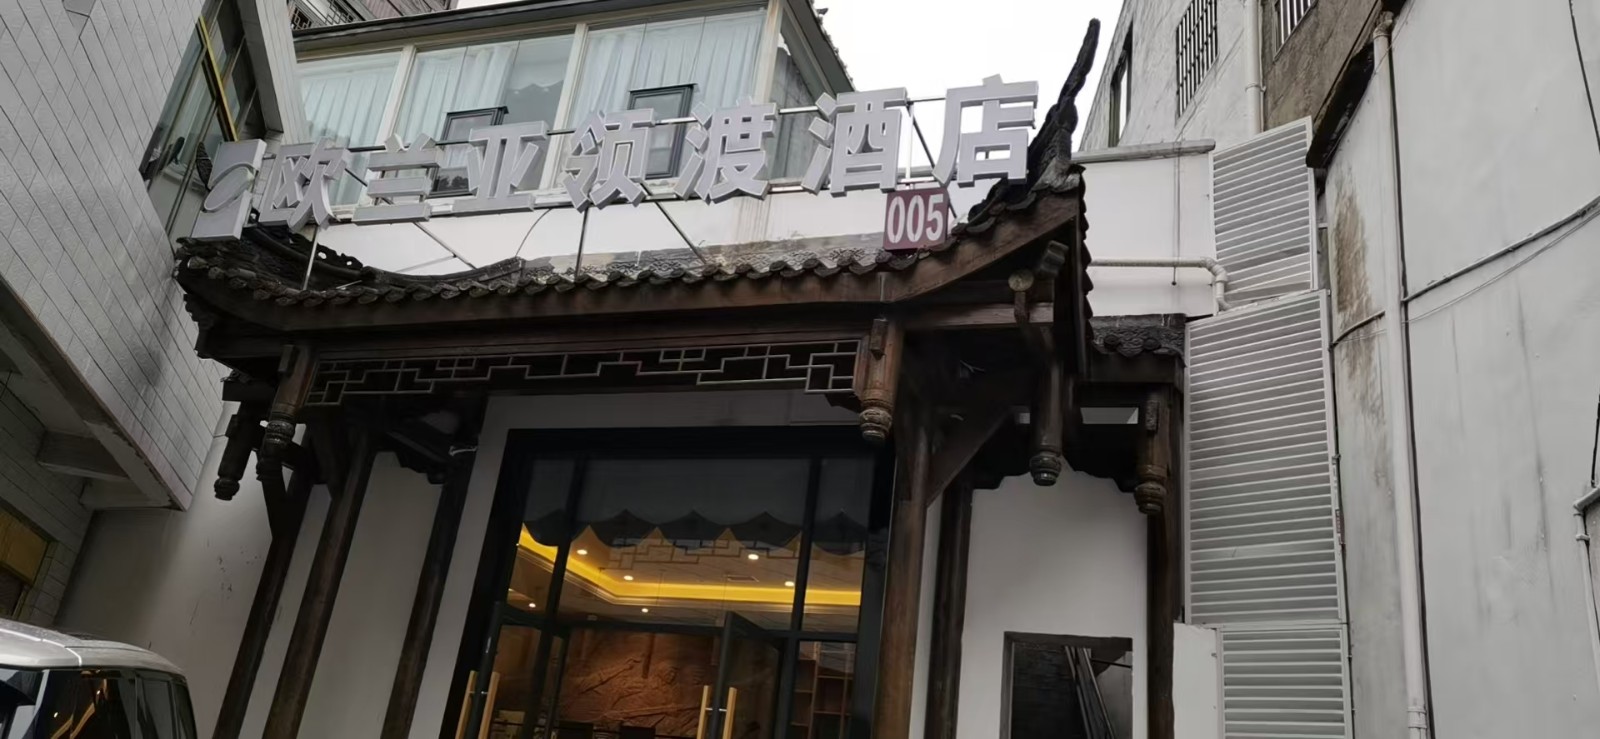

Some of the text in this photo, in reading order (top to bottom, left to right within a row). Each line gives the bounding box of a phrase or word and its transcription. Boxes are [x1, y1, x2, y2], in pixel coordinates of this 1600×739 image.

[258, 74, 1039, 229] 欧兰亚领渡酒店
[887, 193, 944, 244] 005
